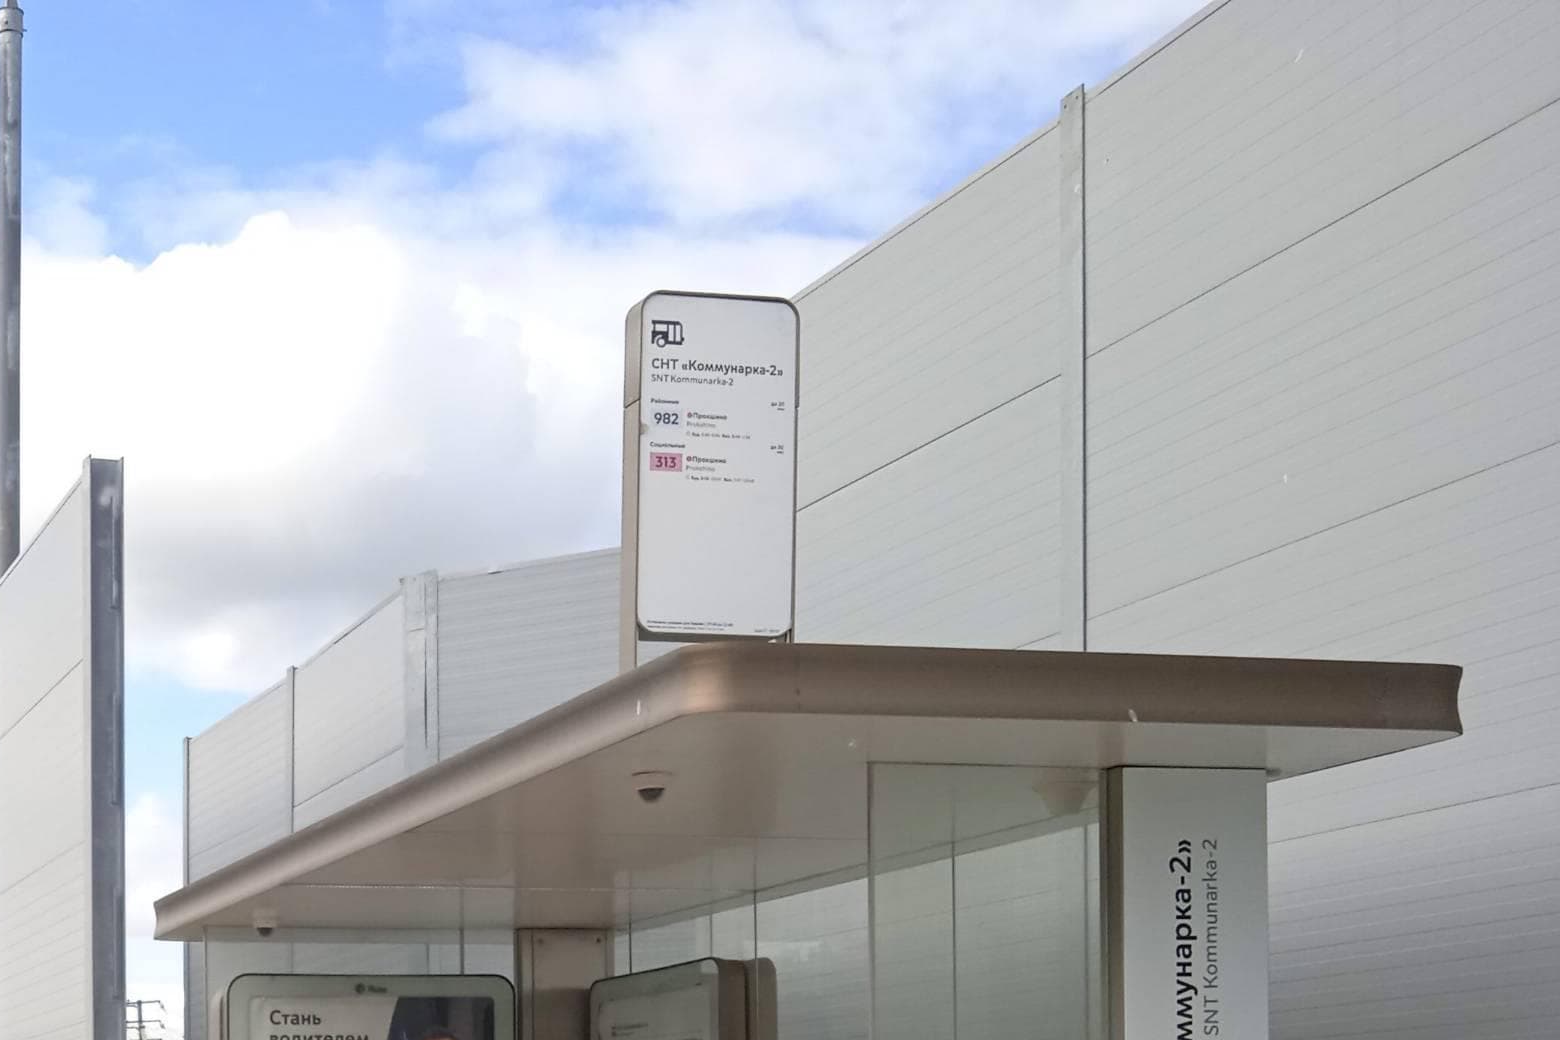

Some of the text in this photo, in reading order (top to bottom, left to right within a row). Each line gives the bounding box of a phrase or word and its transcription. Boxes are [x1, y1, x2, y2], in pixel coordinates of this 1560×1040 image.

[651, 358, 783, 377] СНТ «Коммунарка-2»
[651, 374, 734, 386] SNT Kommunarka-2
[654, 412, 679, 425] 982
[655, 456, 677, 468] 313
[1202, 839, 1219, 1036] SNT Kommunarka-2
[269, 1009, 321, 1025] Стань
